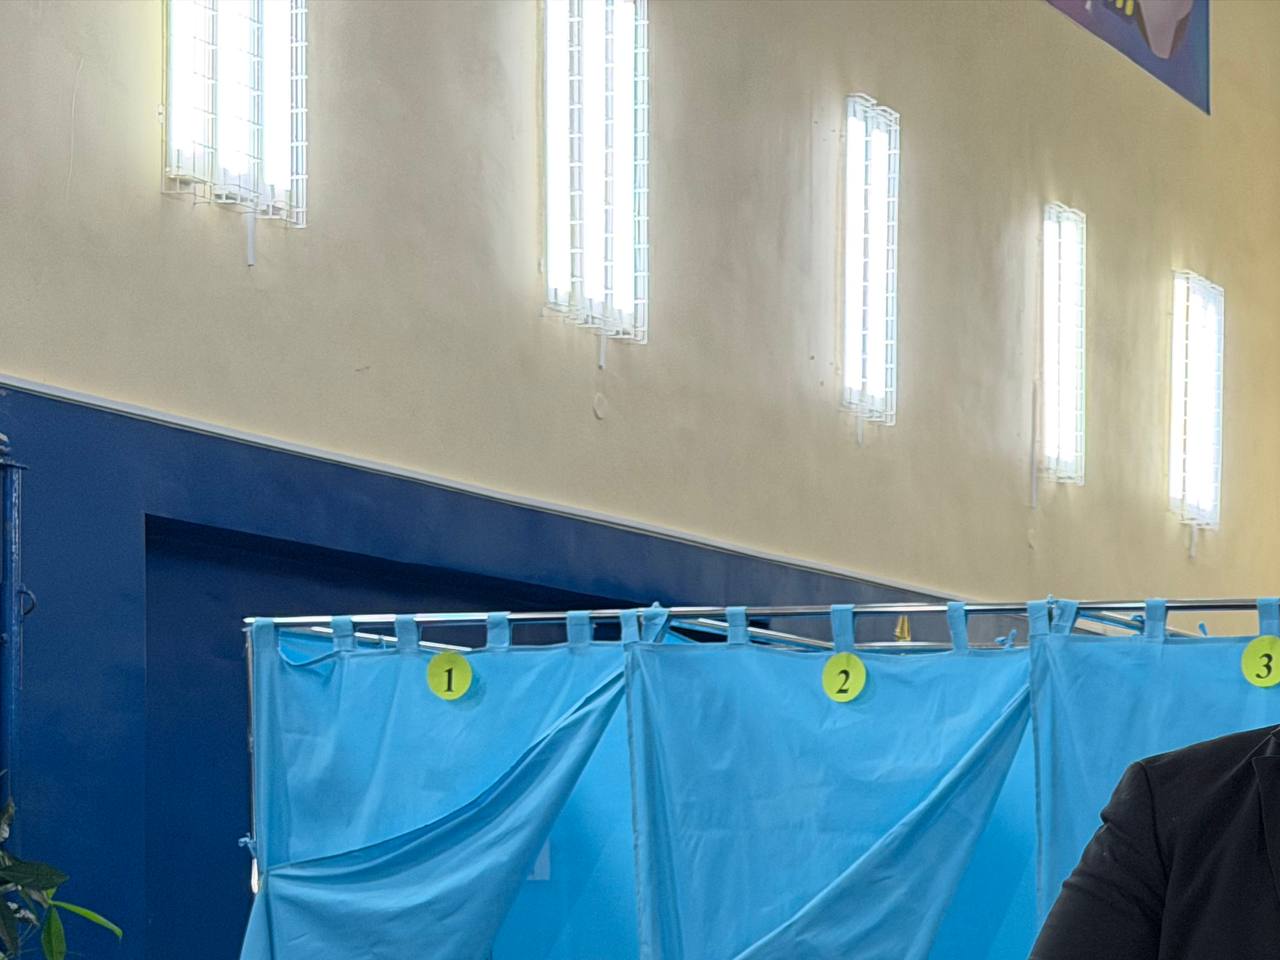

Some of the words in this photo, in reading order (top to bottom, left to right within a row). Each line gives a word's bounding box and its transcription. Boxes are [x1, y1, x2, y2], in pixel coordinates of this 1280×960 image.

[1255, 653, 1273, 679] 3
[443, 667, 454, 692] 1
[836, 669, 850, 694] 2
